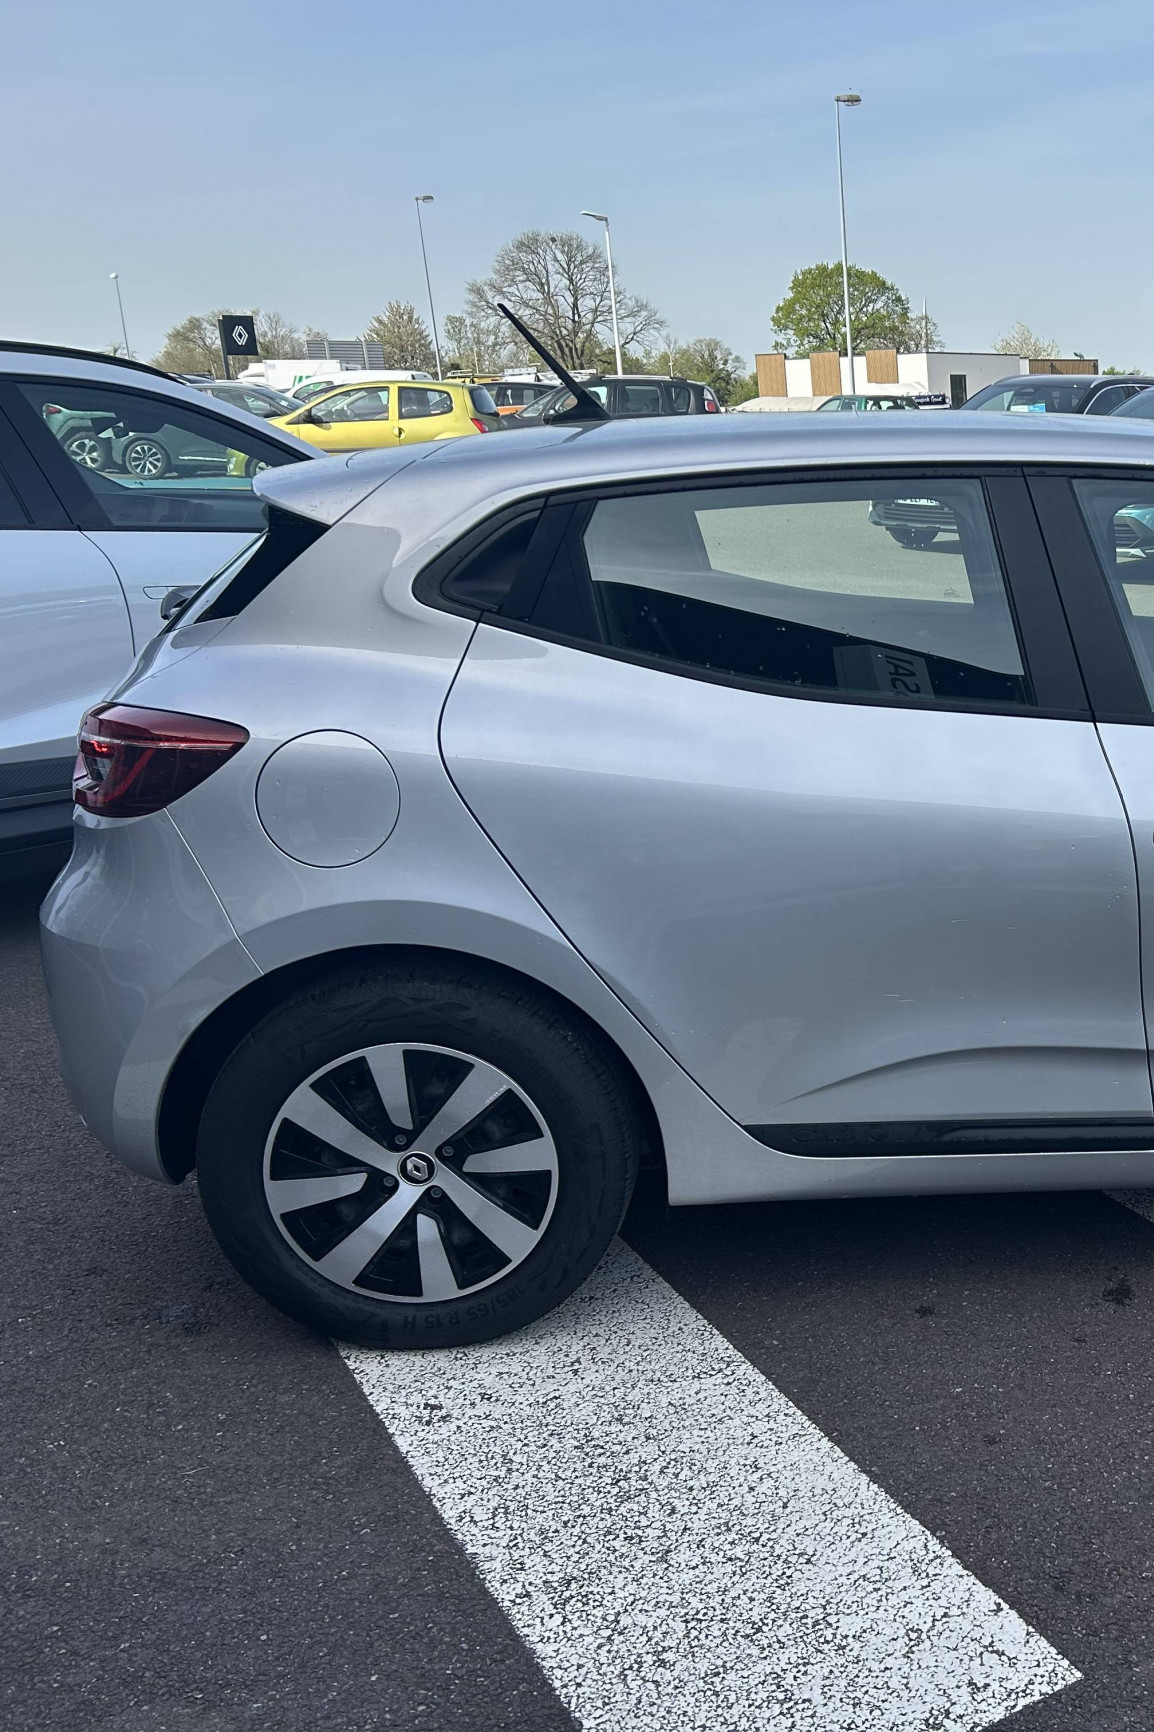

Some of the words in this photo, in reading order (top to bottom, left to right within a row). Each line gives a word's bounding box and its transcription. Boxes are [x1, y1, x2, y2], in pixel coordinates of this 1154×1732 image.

[466, 1284, 524, 1321] 185/65
[404, 1314, 417, 1330] H
[425, 1314, 442, 1328] 15
[447, 1311, 460, 1325] R
